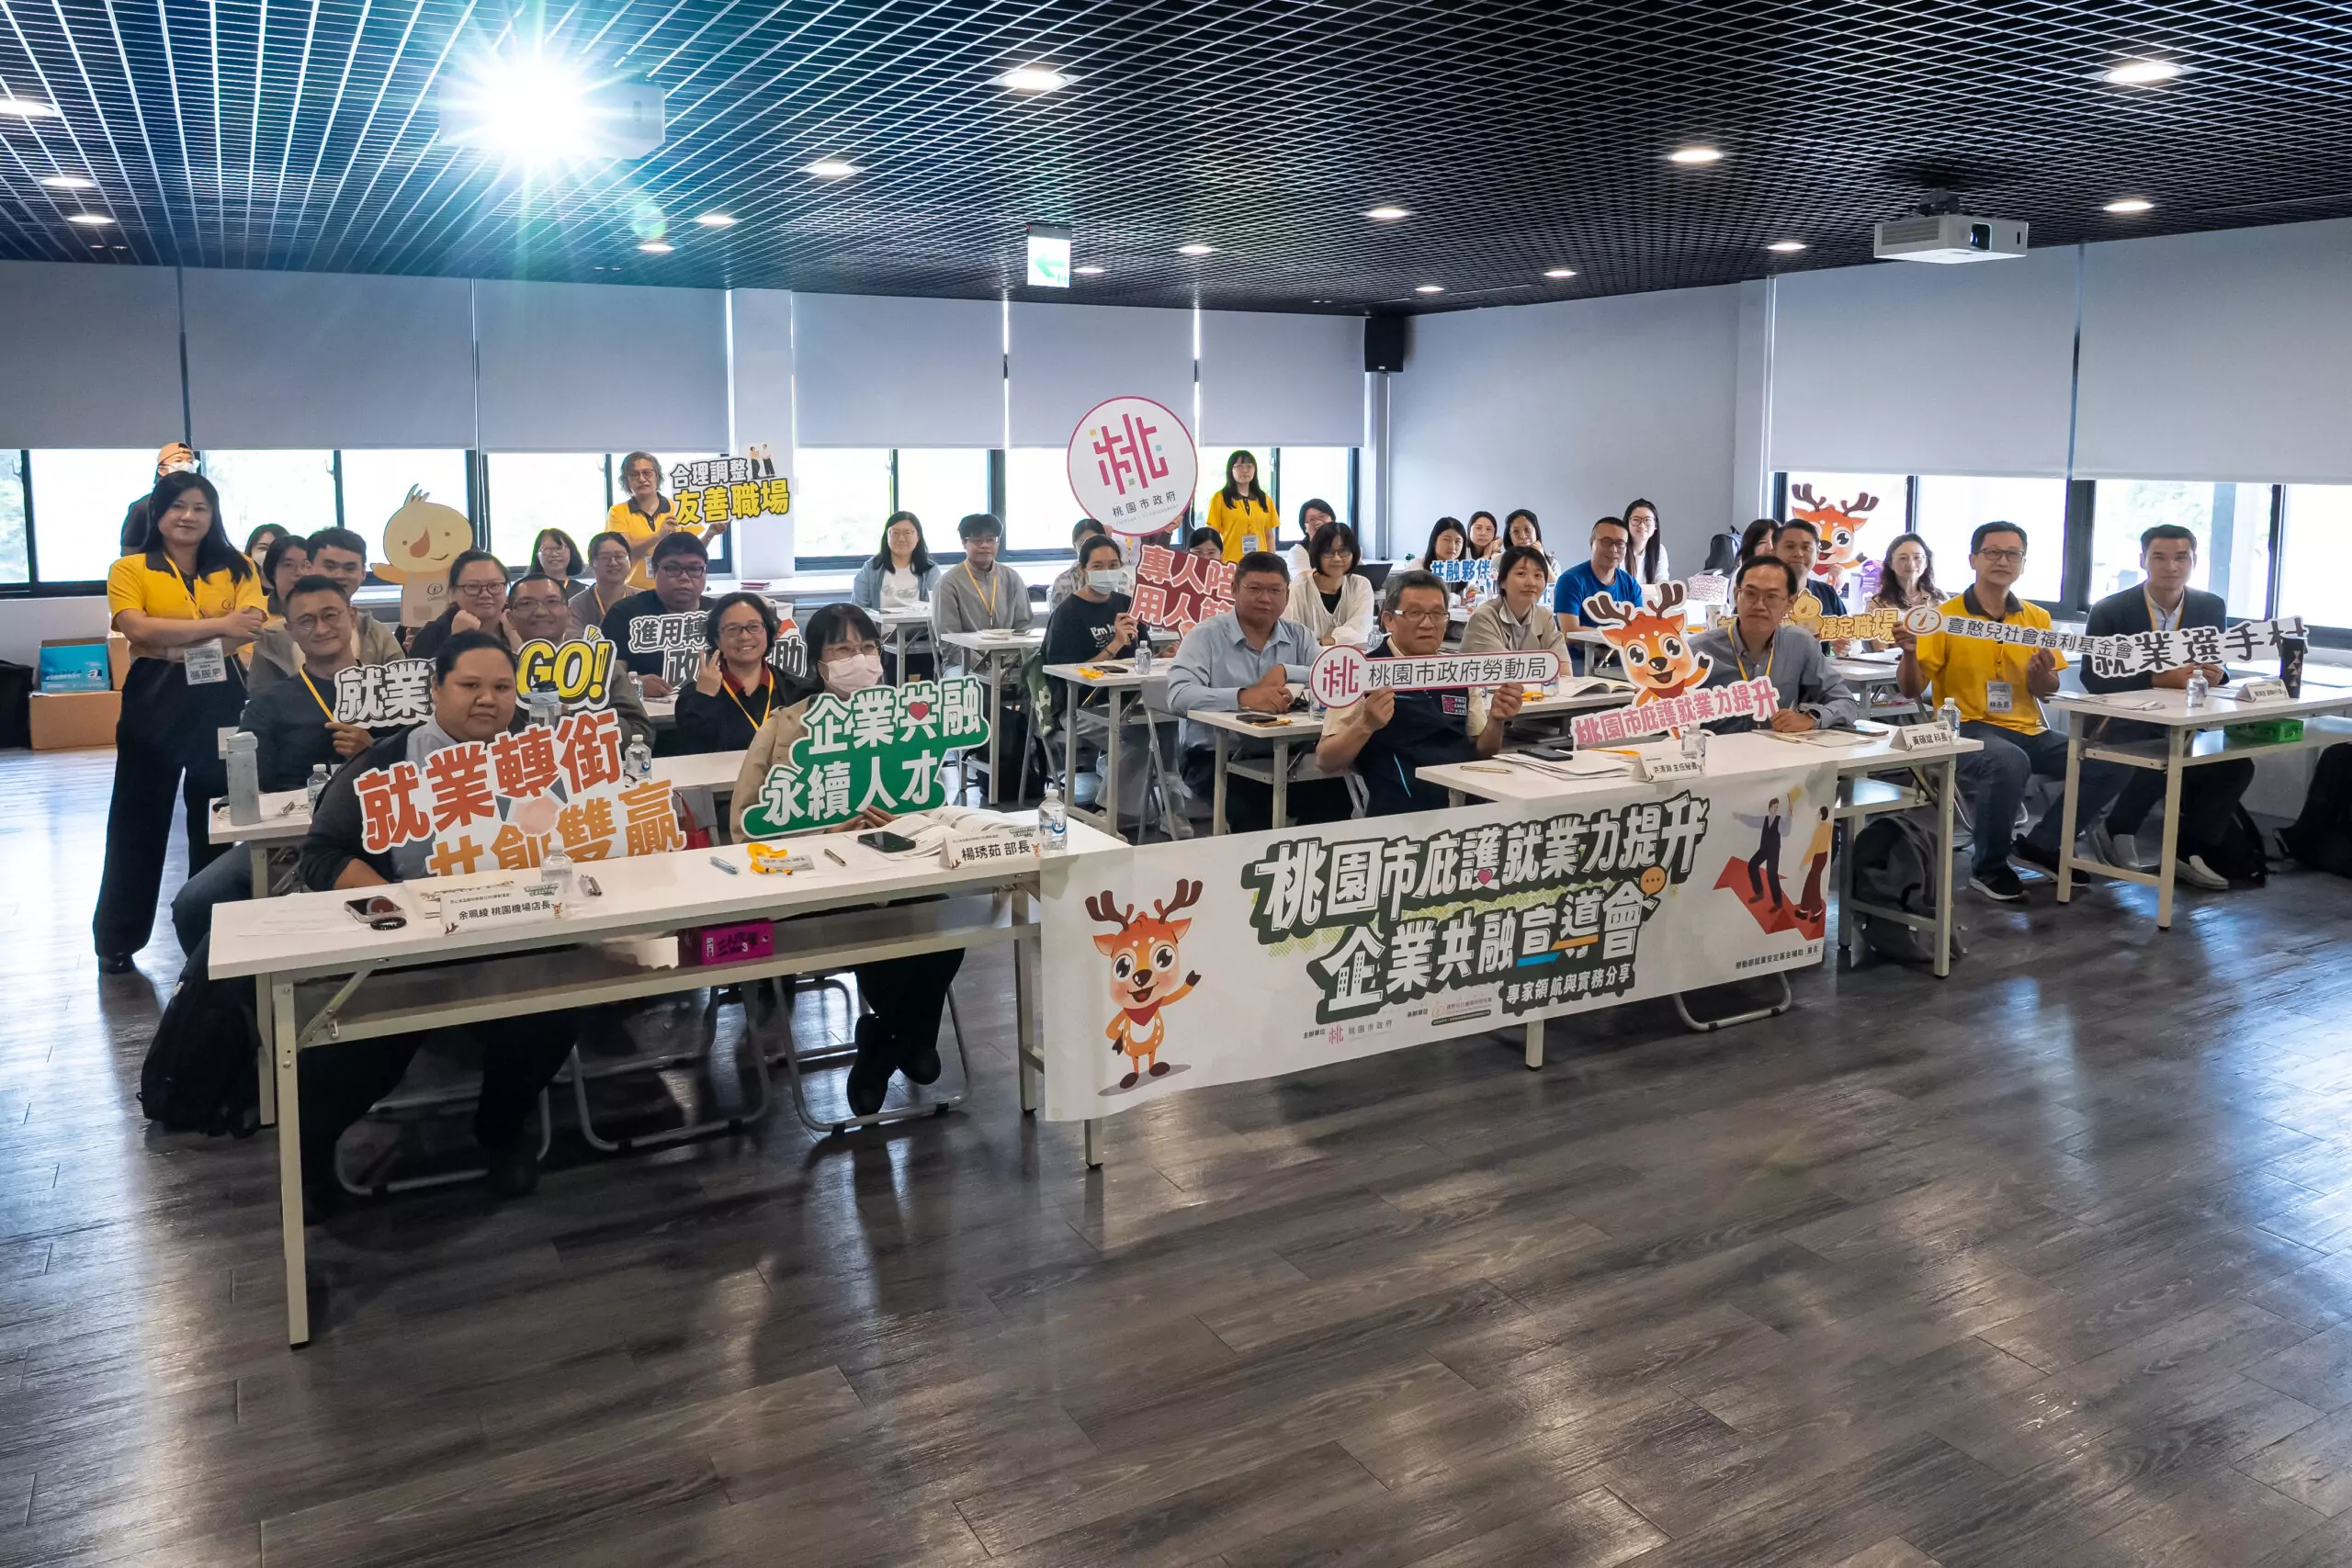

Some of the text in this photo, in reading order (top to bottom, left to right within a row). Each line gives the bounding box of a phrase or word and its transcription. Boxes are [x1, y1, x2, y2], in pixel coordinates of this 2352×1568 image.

[670, 457, 748, 489] 合理調整
[673, 478, 790, 525] 友善職場
[1112, 491, 1177, 518] 桃園市政府
[1820, 610, 1899, 641] 穩定職場
[1947, 616, 2134, 660] 喜憨兒社會福利基金會
[516, 640, 613, 704] GO!
[1368, 656, 1547, 688] 桃園市政府勞動局
[805, 678, 982, 755] 企業共融
[1575, 677, 1780, 746] 桃園市庇護就業力提升
[356, 712, 622, 852] 就業轉銜
[762, 749, 938, 827] 永續人才
[961, 840, 1031, 862] 楊琇茹 部長
[1253, 793, 1710, 932] 桃園市庇護就業力提升
[491, 899, 551, 917] 桃園機場店長
[1318, 881, 1645, 1012] 企業共融宣導會
[1506, 963, 1631, 1005] 專家領航與實務分享
[1348, 1020, 1393, 1036] 桃園市政府
